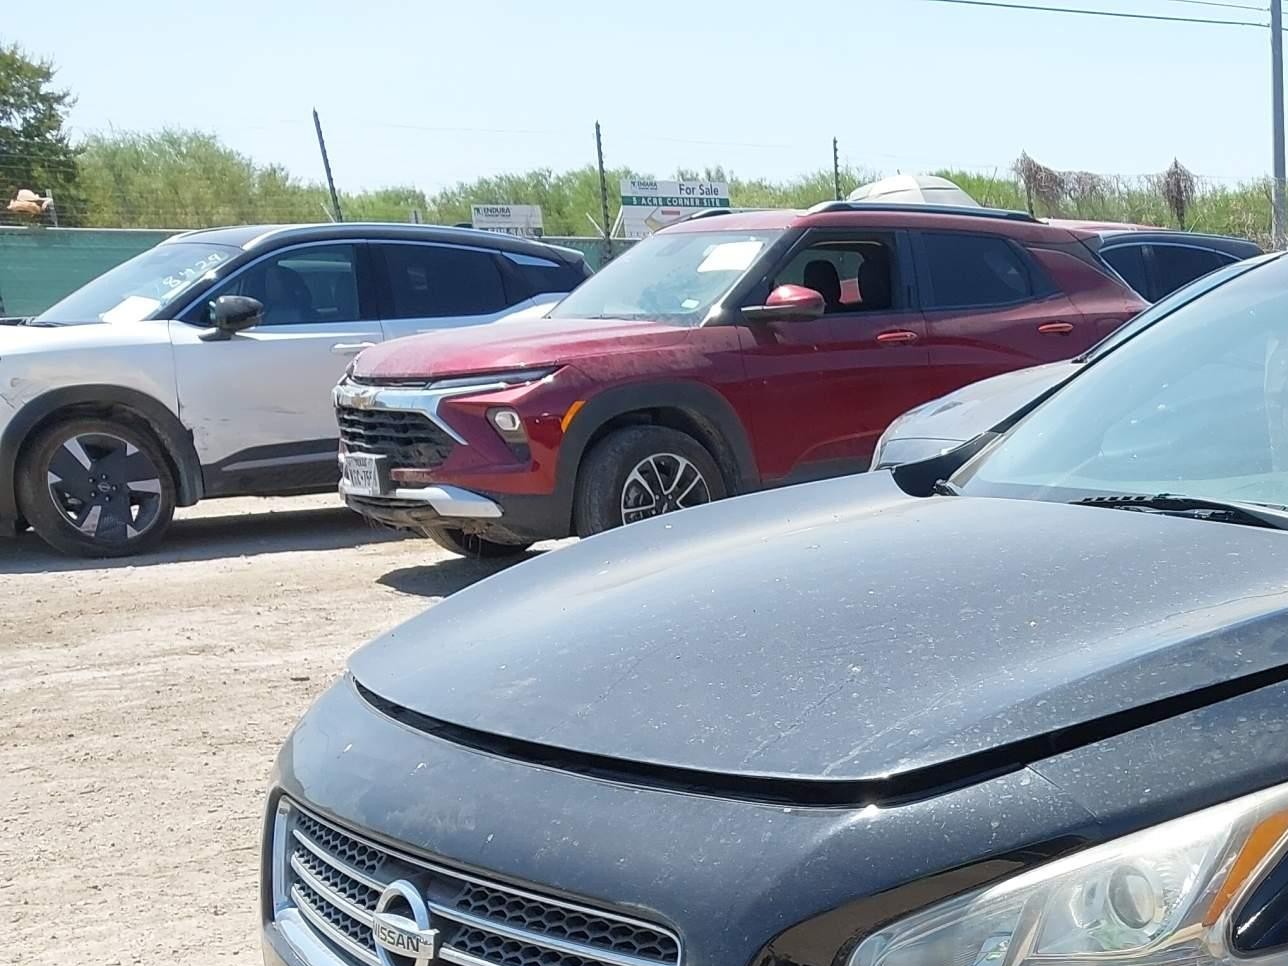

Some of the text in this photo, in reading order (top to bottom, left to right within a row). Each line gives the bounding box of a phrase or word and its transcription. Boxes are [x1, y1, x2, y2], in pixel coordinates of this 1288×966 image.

[679, 183, 719, 196] For Sale
[642, 197, 662, 206] ACRE
[667, 198, 700, 207] CORNER
[703, 198, 720, 207] SITE
